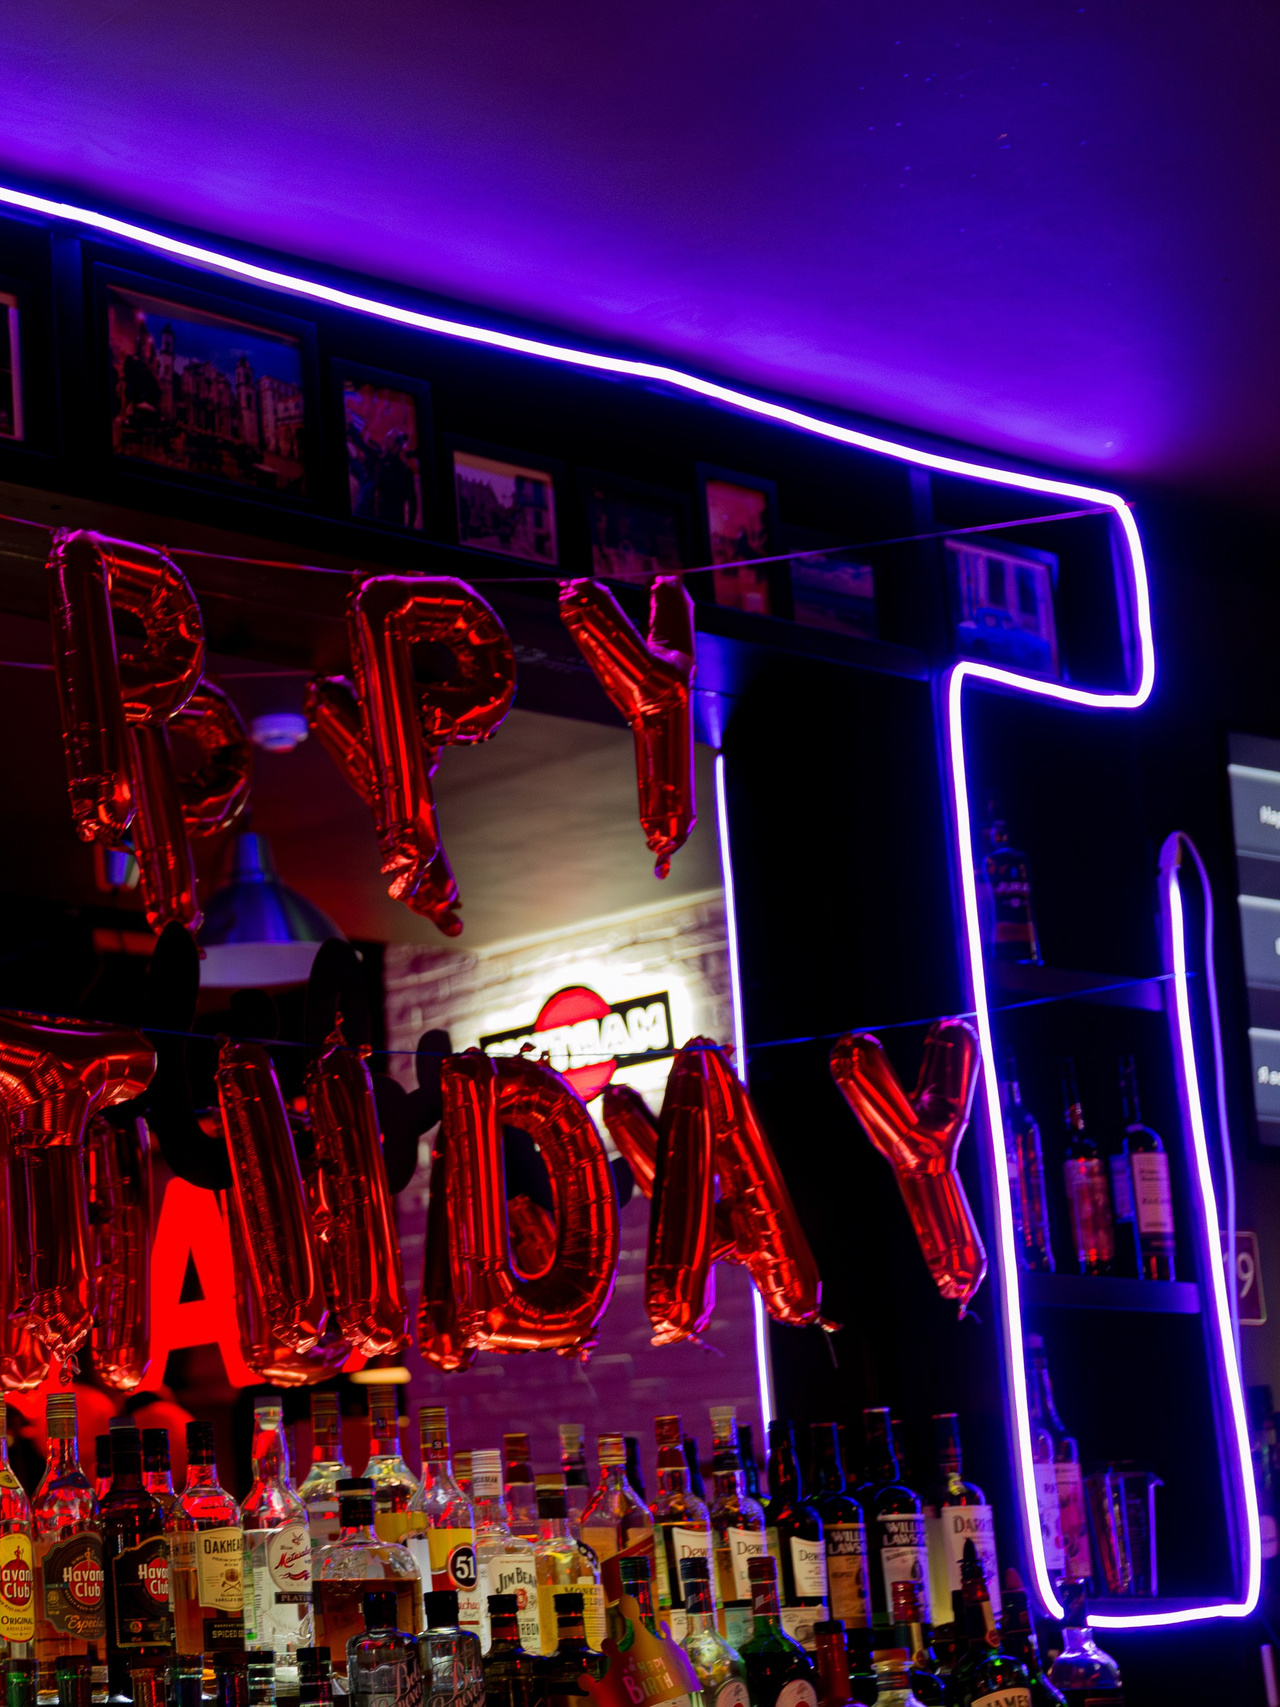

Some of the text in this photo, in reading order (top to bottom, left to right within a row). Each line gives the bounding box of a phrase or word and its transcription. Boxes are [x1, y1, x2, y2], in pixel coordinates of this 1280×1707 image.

[454, 1555, 477, 1579] 51
[4, 1582, 30, 1598] Club
[74, 1582, 100, 1598] Club
[496, 1573, 515, 1594] JIM
